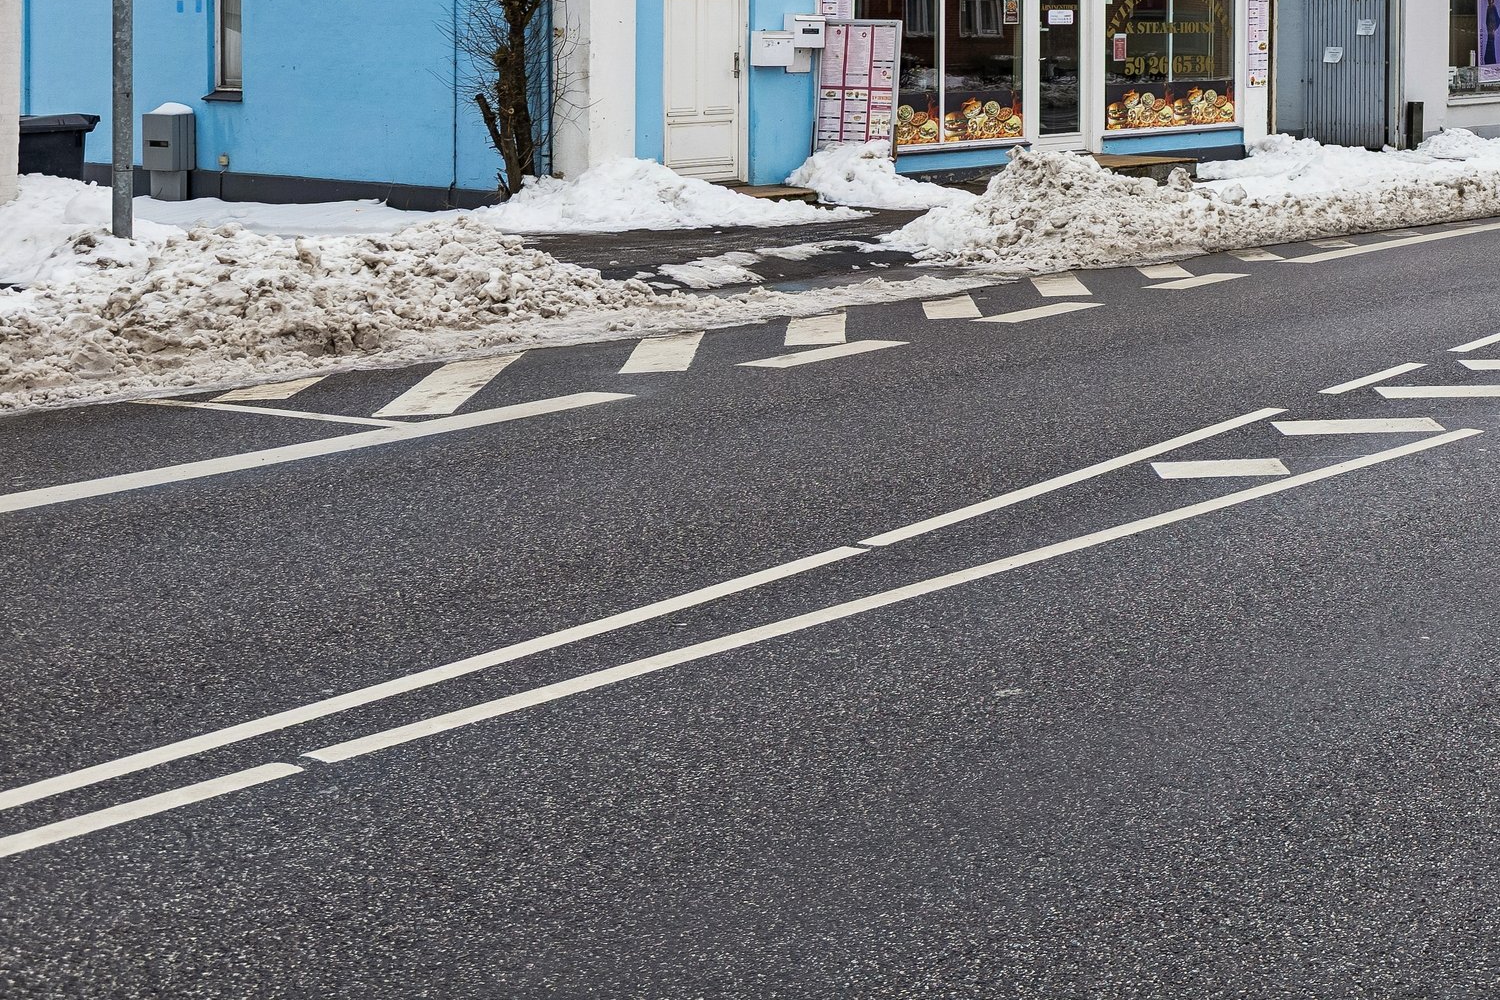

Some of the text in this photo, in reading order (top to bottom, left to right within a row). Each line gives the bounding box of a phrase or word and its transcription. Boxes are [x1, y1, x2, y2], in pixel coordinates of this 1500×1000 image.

[1125, 21, 1134, 34] &
[1124, 56, 1145, 75] 59
[1149, 56, 1169, 75] 26
[1173, 55, 1193, 74] 65
